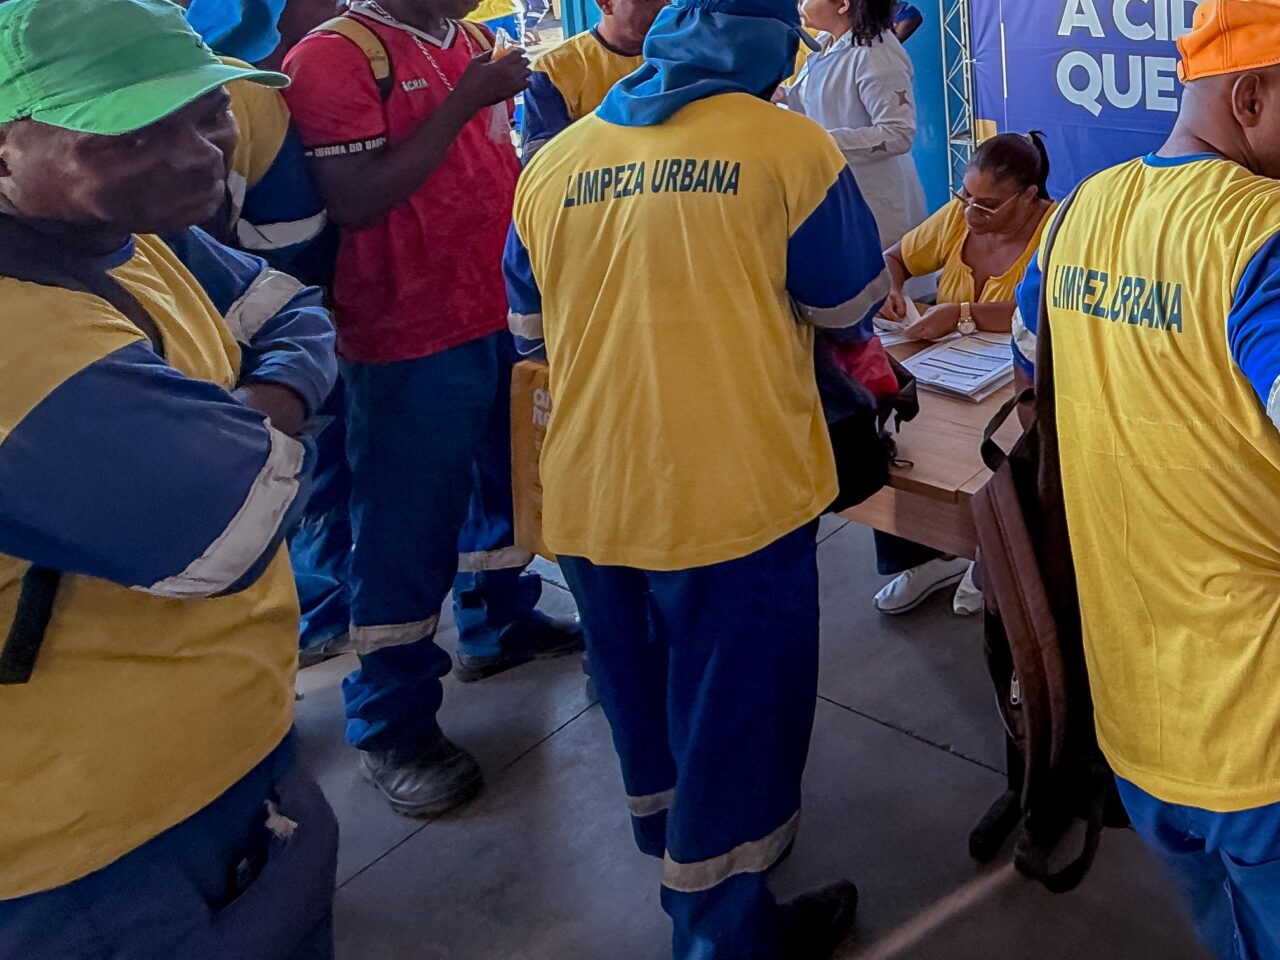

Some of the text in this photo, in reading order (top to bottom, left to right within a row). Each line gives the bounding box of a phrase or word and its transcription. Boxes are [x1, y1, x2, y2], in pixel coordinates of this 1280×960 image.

[1056, 50, 1178, 117] QUE
[563, 158, 742, 208] LIMPEZA URBANA
[1052, 264, 1183, 333] LIMPEZ URBANA
